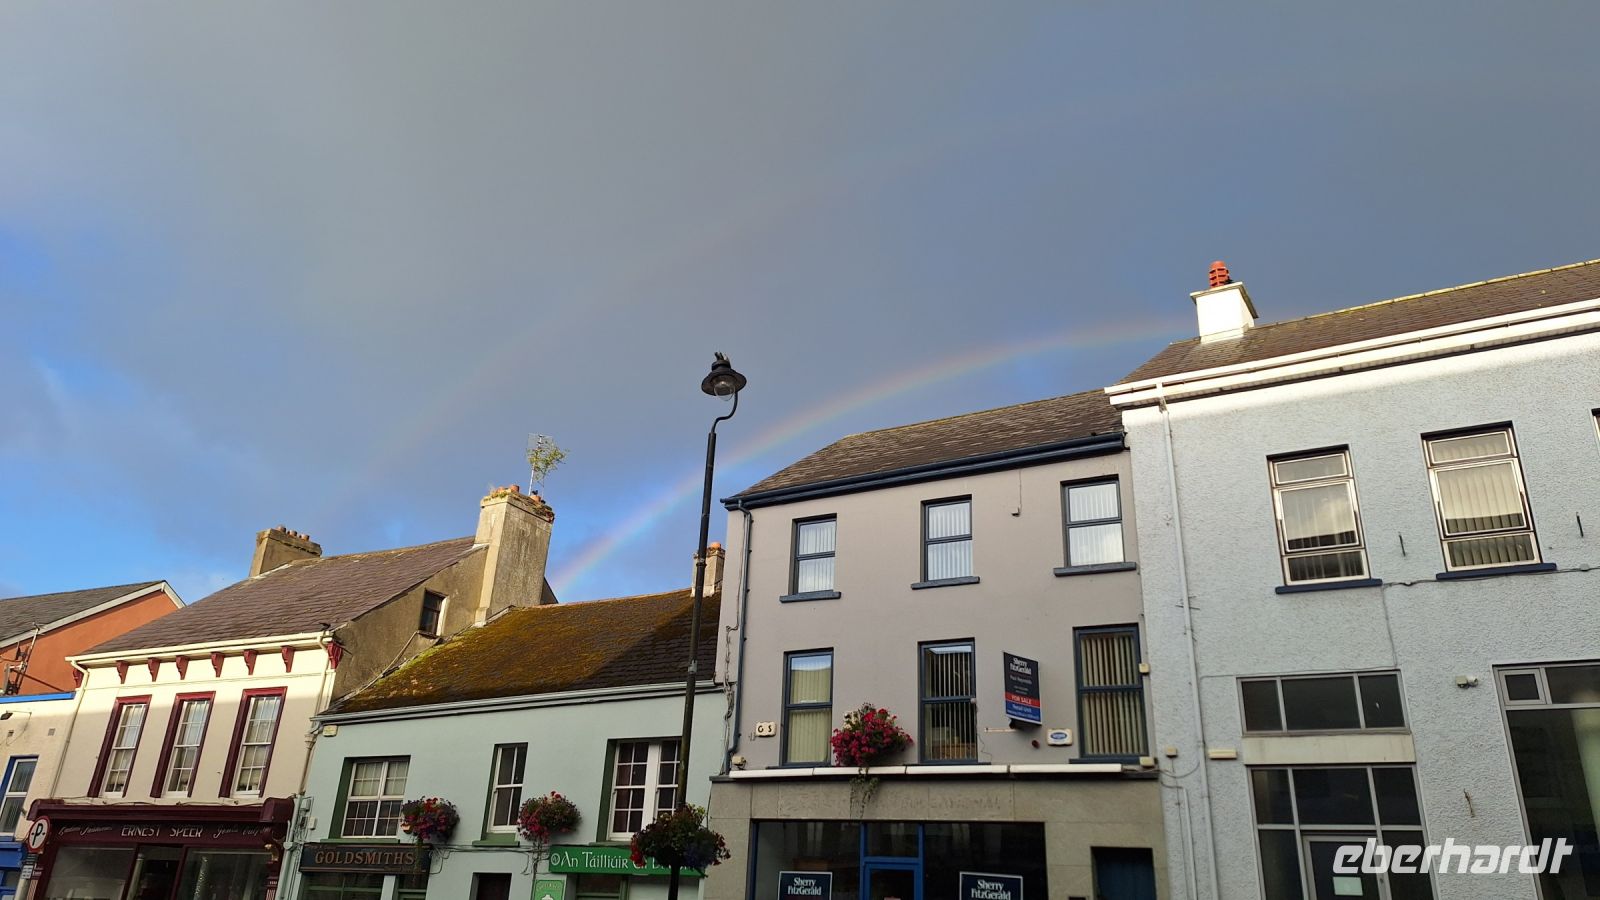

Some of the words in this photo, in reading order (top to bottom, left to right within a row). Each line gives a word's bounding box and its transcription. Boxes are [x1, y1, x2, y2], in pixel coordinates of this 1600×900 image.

[1011, 694, 1020, 702] FOR
[1021, 696, 1032, 704] SALE
[121, 825, 161, 837] ERNEST
[169, 825, 204, 838] SPEER
[314, 851, 416, 865] GOLDSMITHS
[560, 851, 579, 868] An
[793, 876, 817, 888] Sherry
[977, 879, 1004, 891] Sherry
[787, 884, 822, 896] FitzGerald
[971, 888, 1011, 900] FitzGerald
